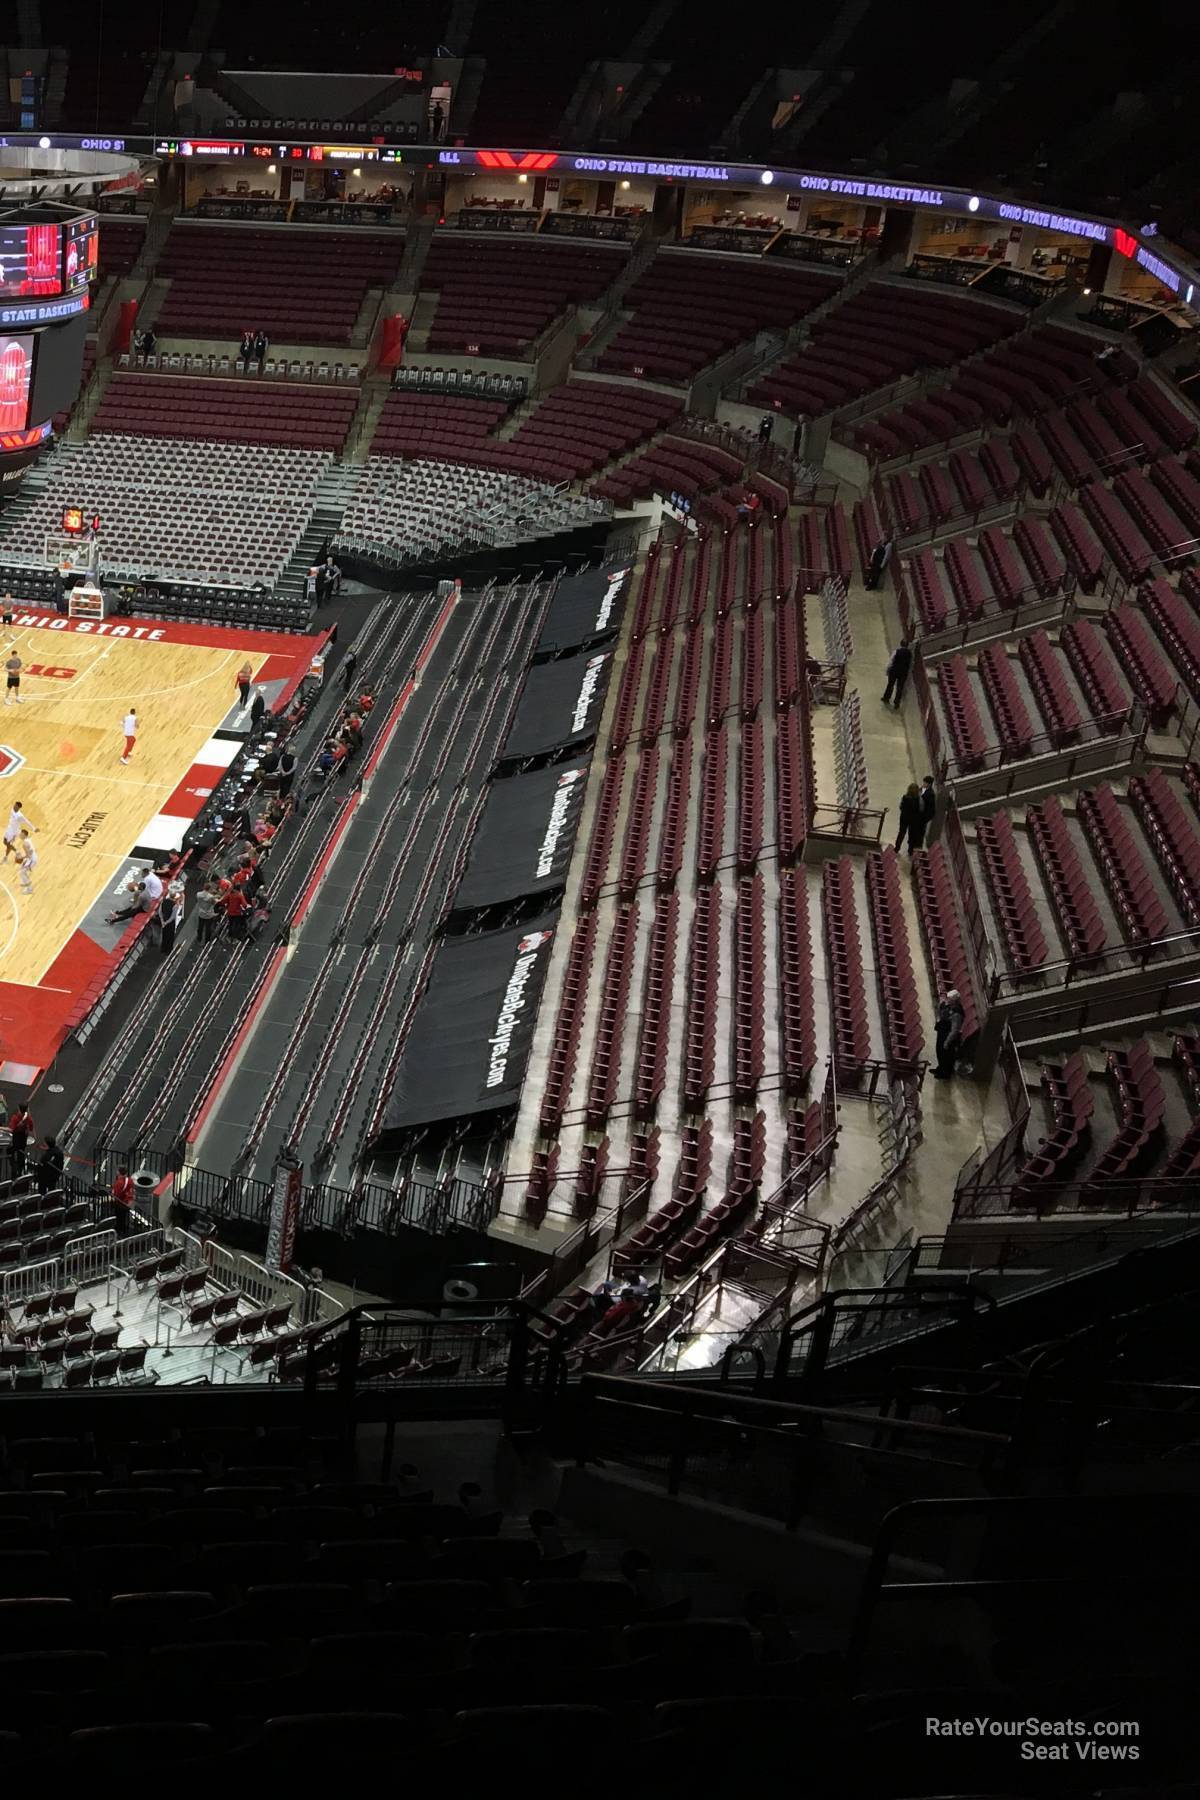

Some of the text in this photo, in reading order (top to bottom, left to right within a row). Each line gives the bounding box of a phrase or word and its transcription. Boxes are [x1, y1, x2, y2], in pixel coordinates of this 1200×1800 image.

[81, 138, 111, 150] OHIO
[253, 146, 272, 157] 7:24
[574, 158, 729, 181] OHIO STATE BASKETBALL
[800, 176, 943, 205] OHIO STATE BASKETBALL
[999, 203, 1107, 241] OHIO STATE BASKETBALL
[2, 308, 37, 322] STATE
[38, 296, 84, 318] BASKETBALL
[66, 516, 79, 528] 30
[75, 621, 167, 640] STATE
[66, 811, 109, 850] VALUE CITY
[486, 953, 538, 1088] OhioStateBuckeyes.com
